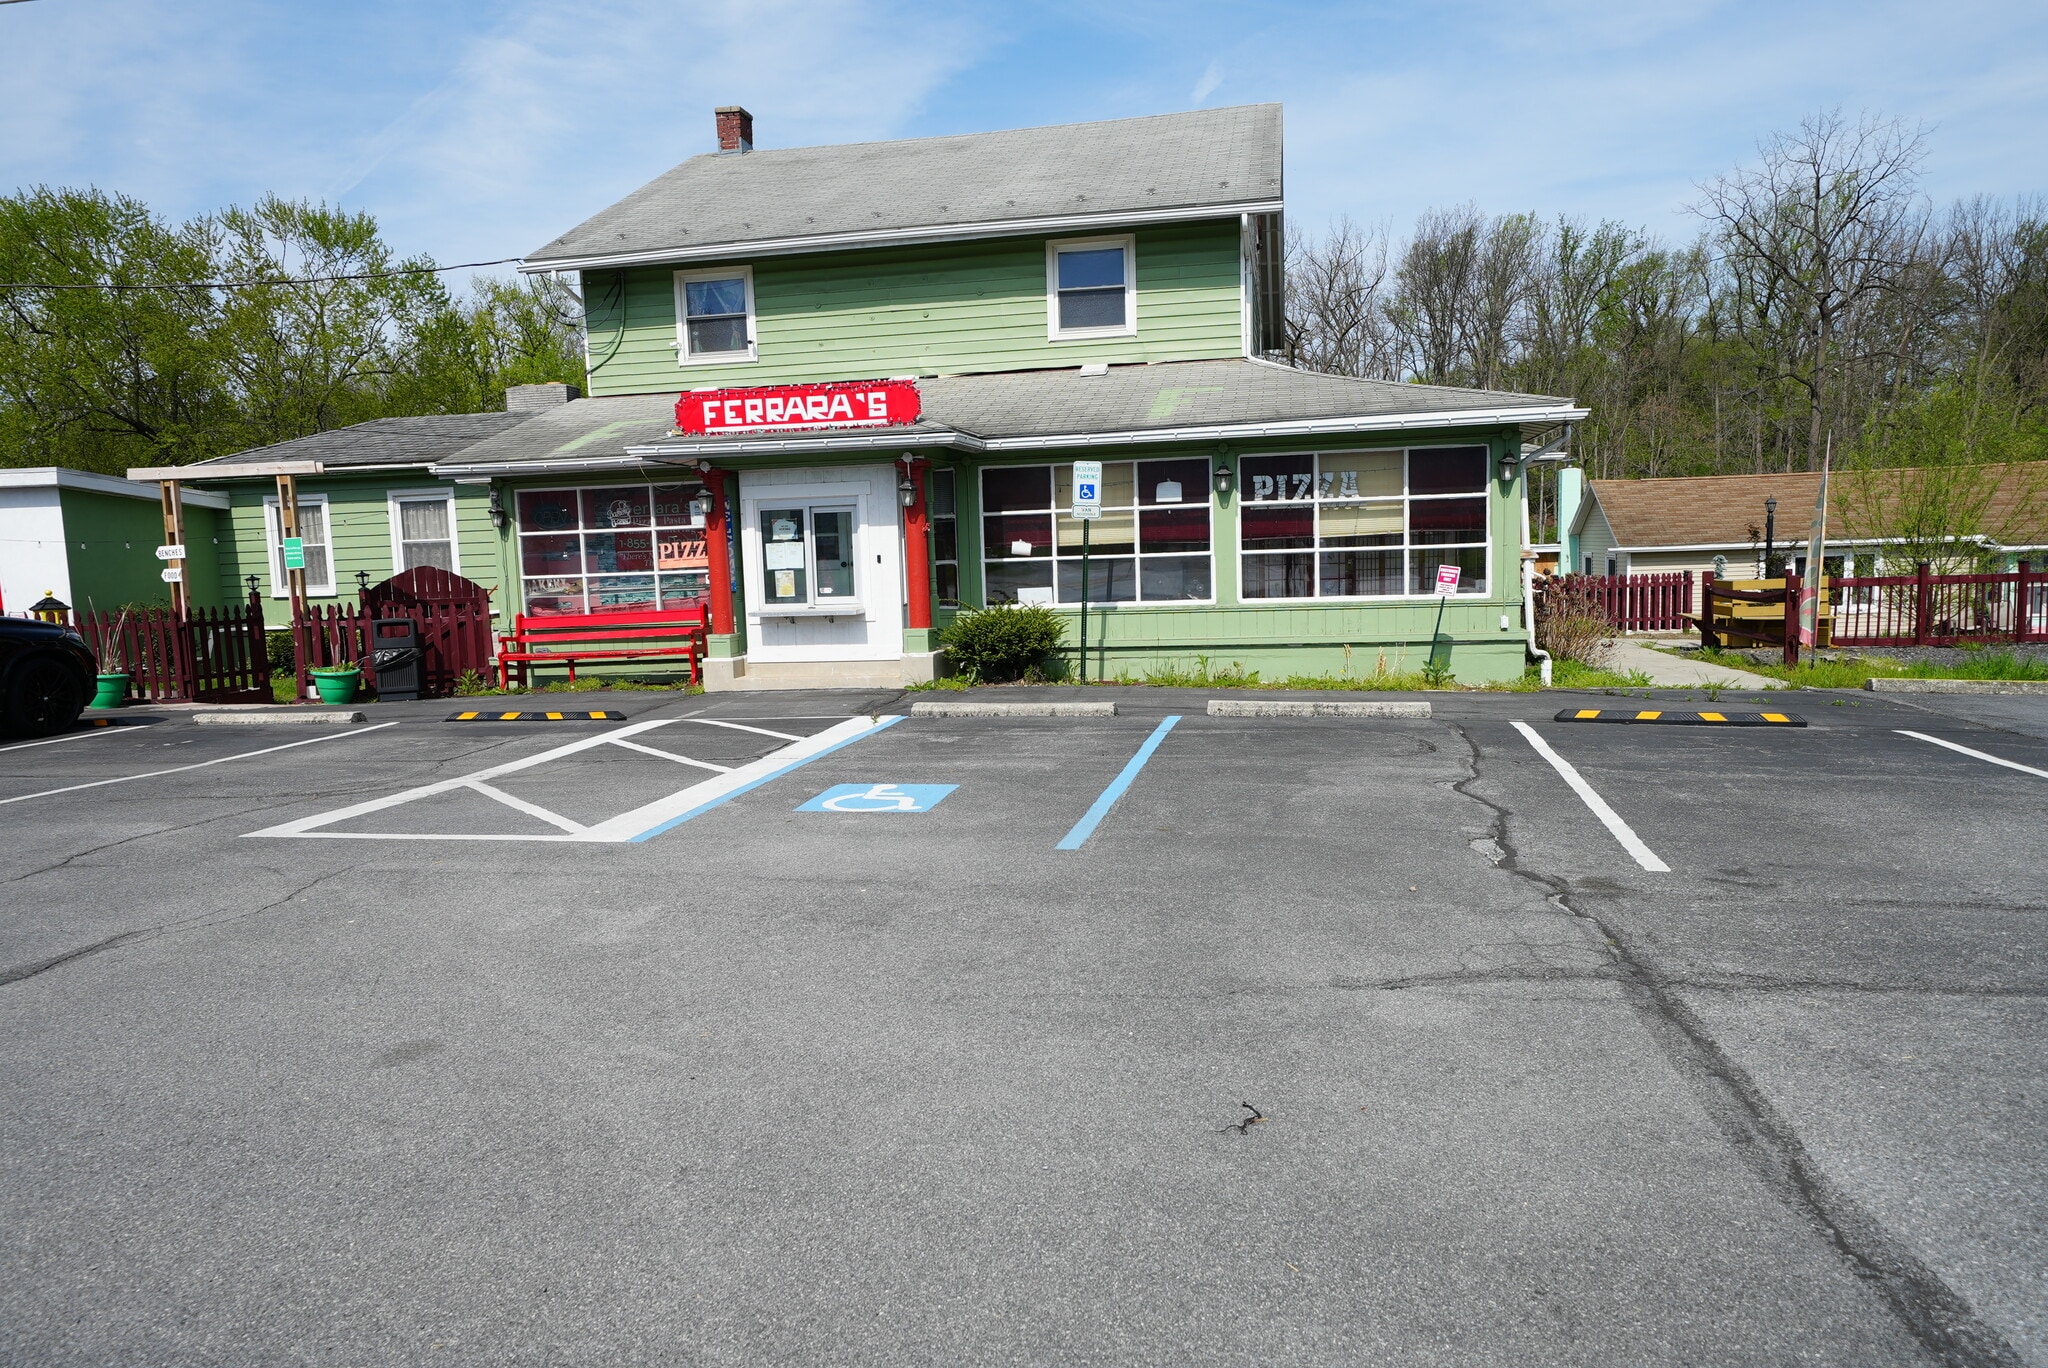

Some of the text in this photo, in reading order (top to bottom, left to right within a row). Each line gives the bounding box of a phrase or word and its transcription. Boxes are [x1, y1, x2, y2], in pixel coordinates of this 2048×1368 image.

[703, 392, 887, 426] FERRARA'S
[1252, 471, 1361, 502] PIZZA
[158, 549, 182, 557] BENCHES
[658, 540, 709, 562] PIZZ
